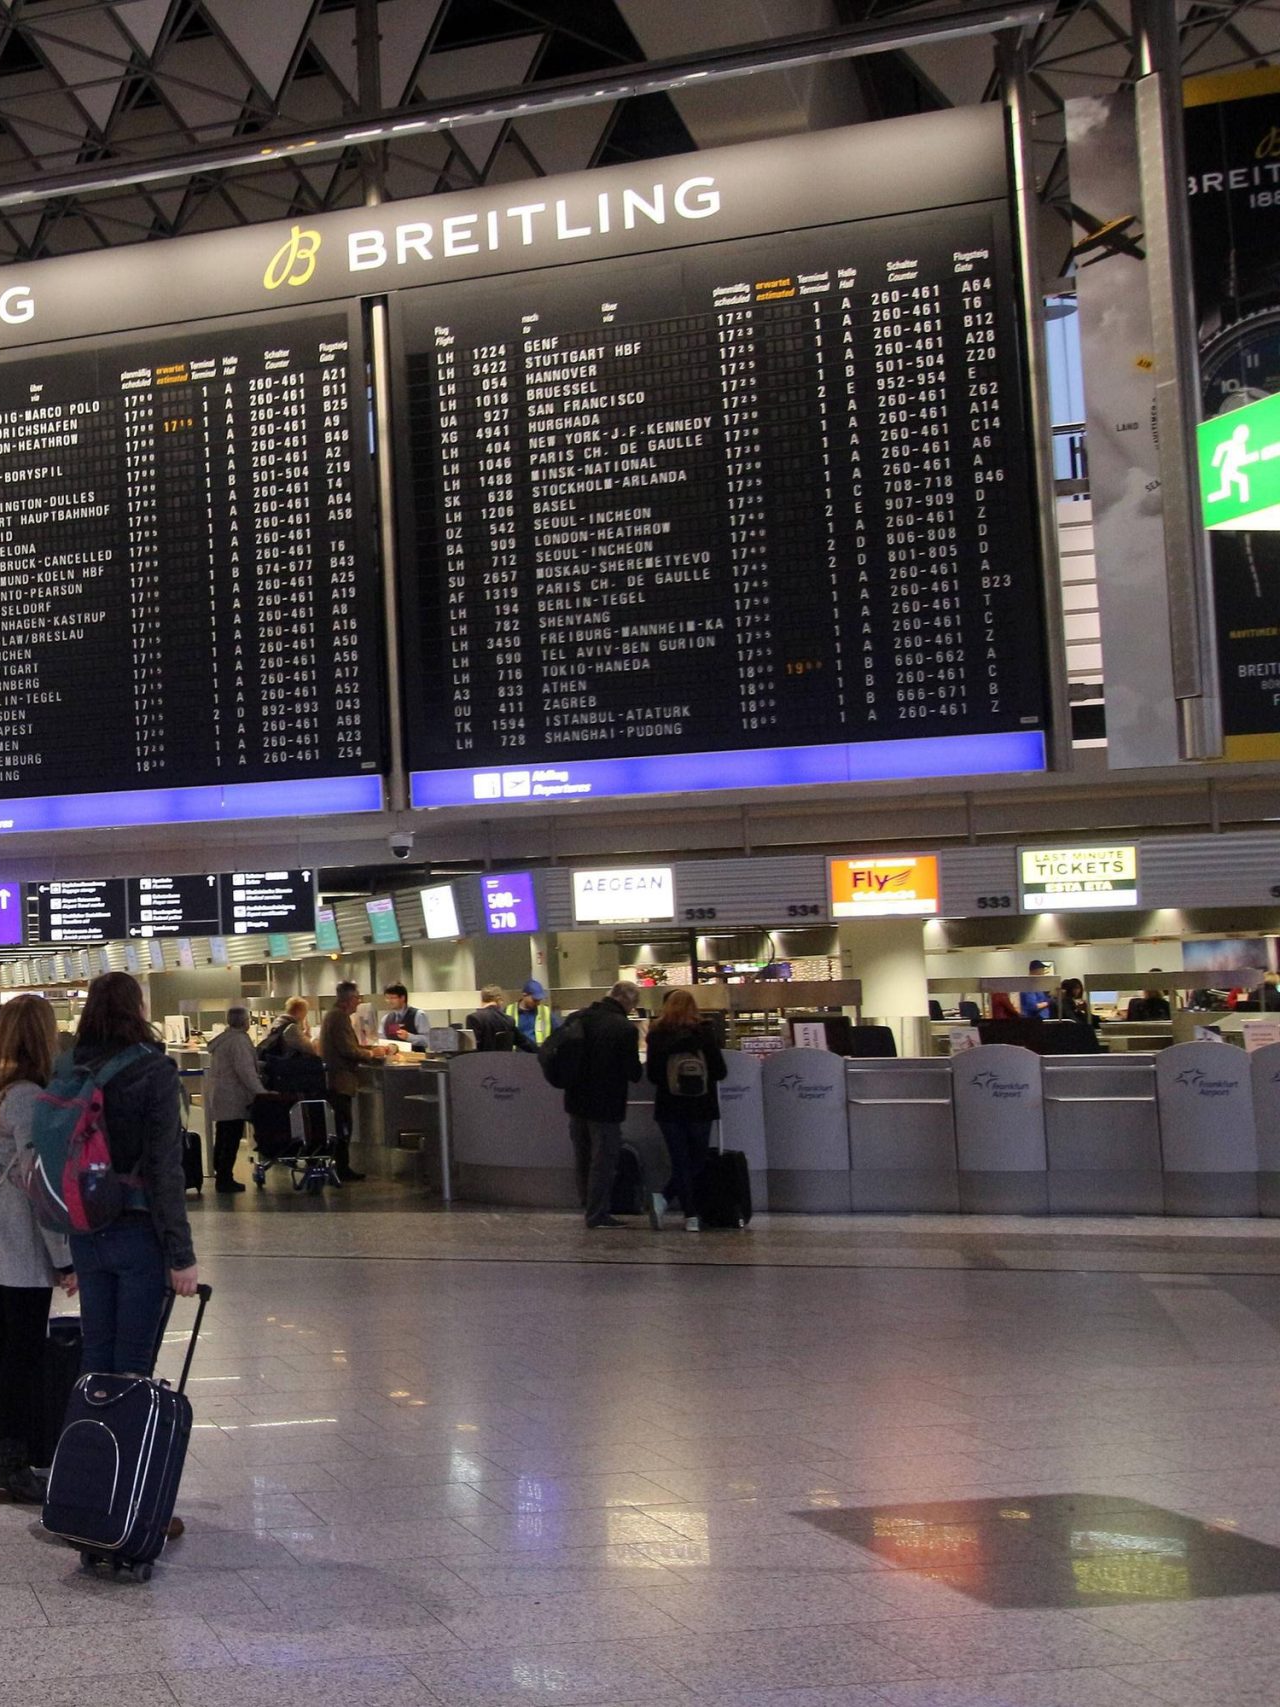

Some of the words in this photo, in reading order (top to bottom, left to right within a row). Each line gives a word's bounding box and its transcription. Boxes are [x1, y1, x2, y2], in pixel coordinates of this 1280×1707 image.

[348, 176, 720, 271] BREITLING
[524, 337, 558, 353] GENF
[525, 347, 605, 369] STUTTGART
[615, 342, 641, 357] HBF
[526, 364, 597, 385] HANNOVER
[527, 381, 597, 401] BRUESSEL
[70, 401, 99, 415] POLO
[528, 403, 554, 417] SAN
[564, 392, 644, 412] FRANCISCO
[528, 414, 600, 433] HURGHADA
[529, 435, 556, 449] NEW
[565, 416, 711, 445] YORK-J.F.KENNEDY
[530, 449, 574, 465] PARIS
[584, 446, 608, 459] CH.
[620, 442, 637, 455] DE
[648, 434, 703, 452] GAULLE
[531, 457, 657, 481] MINSK-NATIONAL
[532, 470, 686, 498] STOCKHOLM-ARLANDA
[20, 505, 109, 525] HAUPTBAHNHOF
[533, 499, 576, 514] BASEL
[534, 508, 651, 530] SEOUL-INCHEON
[535, 522, 670, 546] LONDON-HEATHROW
[536, 541, 653, 563] SEOUL-INCHEON
[82, 566, 104, 578] HBF
[536, 551, 710, 579] MOSKAU-SHEREMETYEVO
[537, 581, 581, 595] PARIS
[591, 578, 615, 590] CH.
[627, 574, 644, 587] DE
[655, 568, 710, 584] GAULLE
[538, 592, 646, 612] BERLIN-TEGEL
[539, 611, 610, 628] SHENYANG
[540, 618, 723, 644] FREIBURG-MANNHEIM-KA
[541, 649, 566, 660] TEL
[659, 636, 715, 651] GURION
[542, 680, 587, 694] ATHEN
[543, 696, 596, 710] ZAGREB
[1036, 861, 1124, 876] TICKETS
[583, 876, 663, 892] AEGEAN
[853, 870, 889, 891] Fly
[788, 904, 819, 917] 534
[977, 896, 1011, 909] 533
[685, 908, 716, 920] 535
